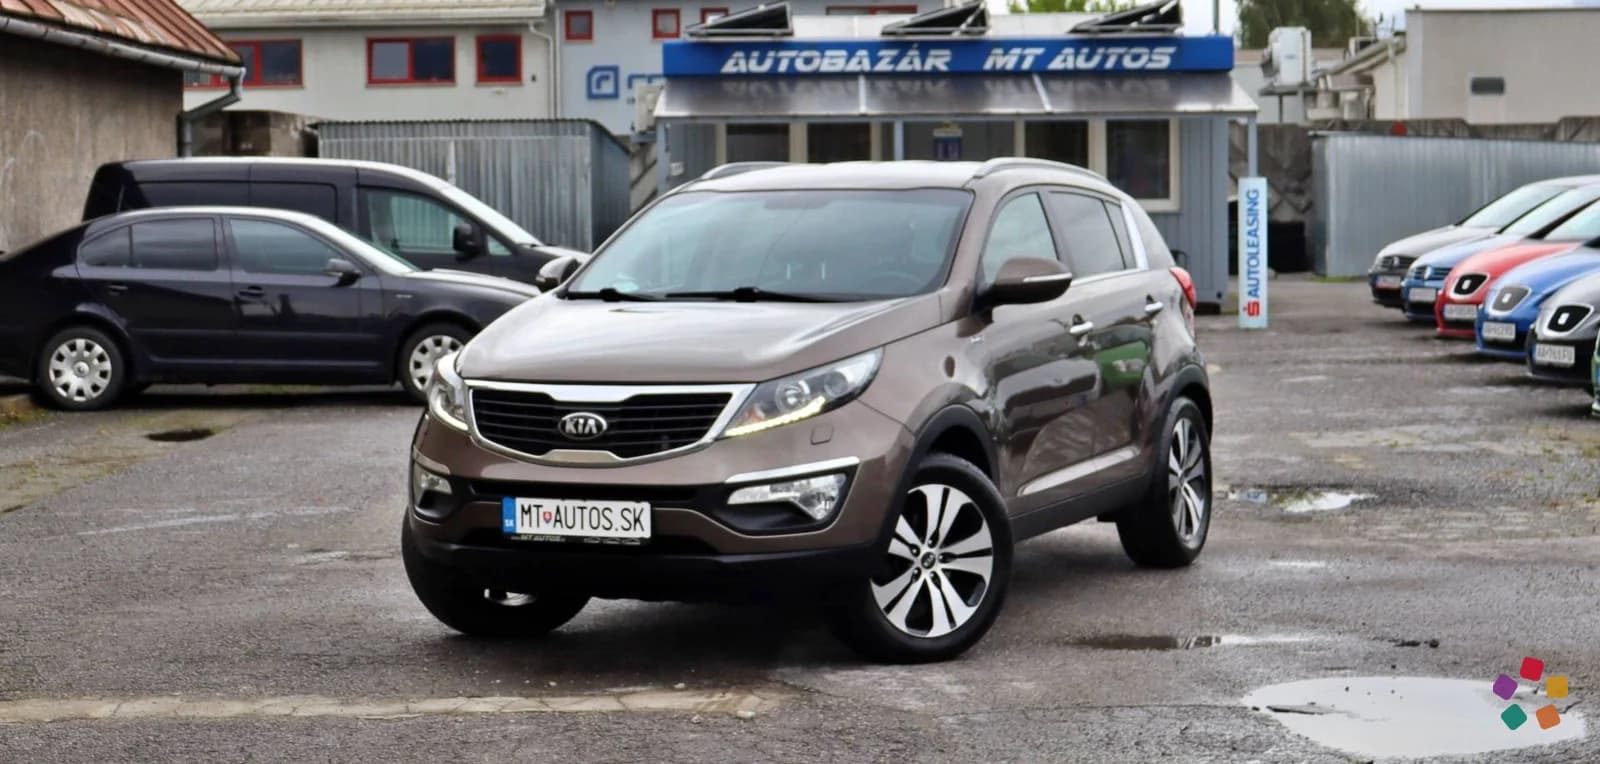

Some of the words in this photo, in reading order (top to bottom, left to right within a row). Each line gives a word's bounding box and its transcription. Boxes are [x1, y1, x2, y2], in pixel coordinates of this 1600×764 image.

[720, 44, 952, 73] AUTOBAZÁR
[983, 48, 1046, 70] MT
[1048, 46, 1177, 70] AUTOS
[1246, 189, 1260, 299] AUTOLEASING
[565, 418, 598, 434] KIA
[553, 505, 645, 532] AUTOS.SK
